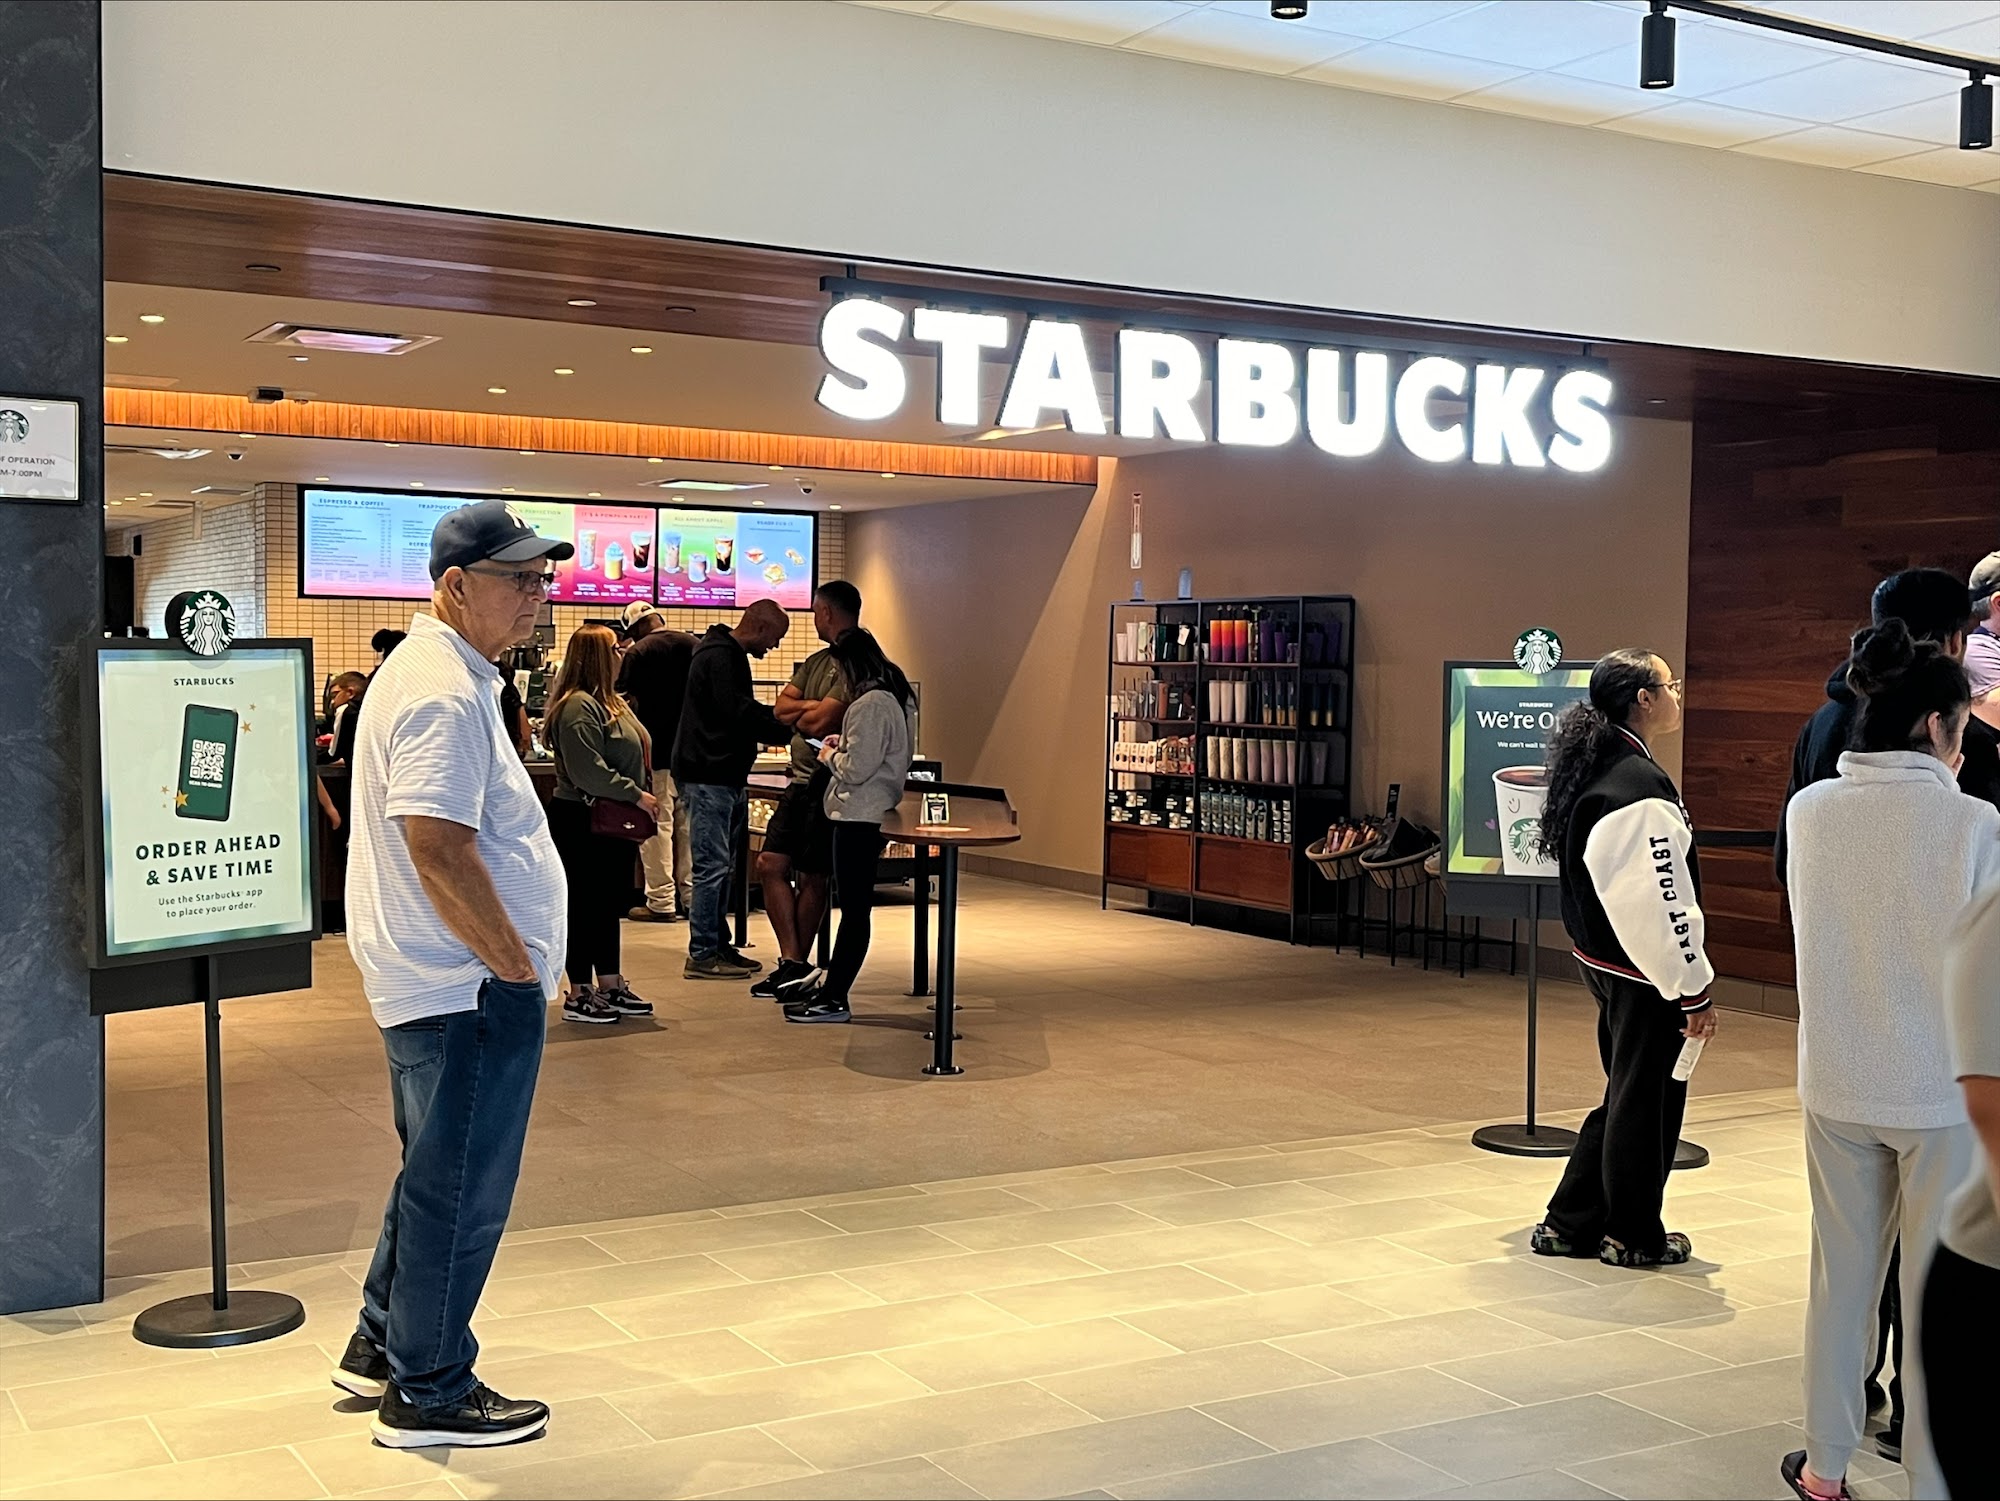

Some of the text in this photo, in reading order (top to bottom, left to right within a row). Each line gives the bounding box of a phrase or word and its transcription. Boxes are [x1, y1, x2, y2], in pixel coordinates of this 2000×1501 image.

[816, 297, 1614, 473] STARBUCKS
[8, 456, 55, 465] OPERATION
[173, 677, 235, 686] STARBUCKS
[1475, 710, 1535, 729] We're
[135, 834, 281, 860] ORDER AHEAD
[146, 859, 273, 886] & SAVE TIME
[1649, 836, 1677, 902] COAST
[158, 897, 175, 906] Use
[178, 895, 193, 904] the
[246, 888, 263, 899] app
[166, 901, 256, 918] to place your order.
